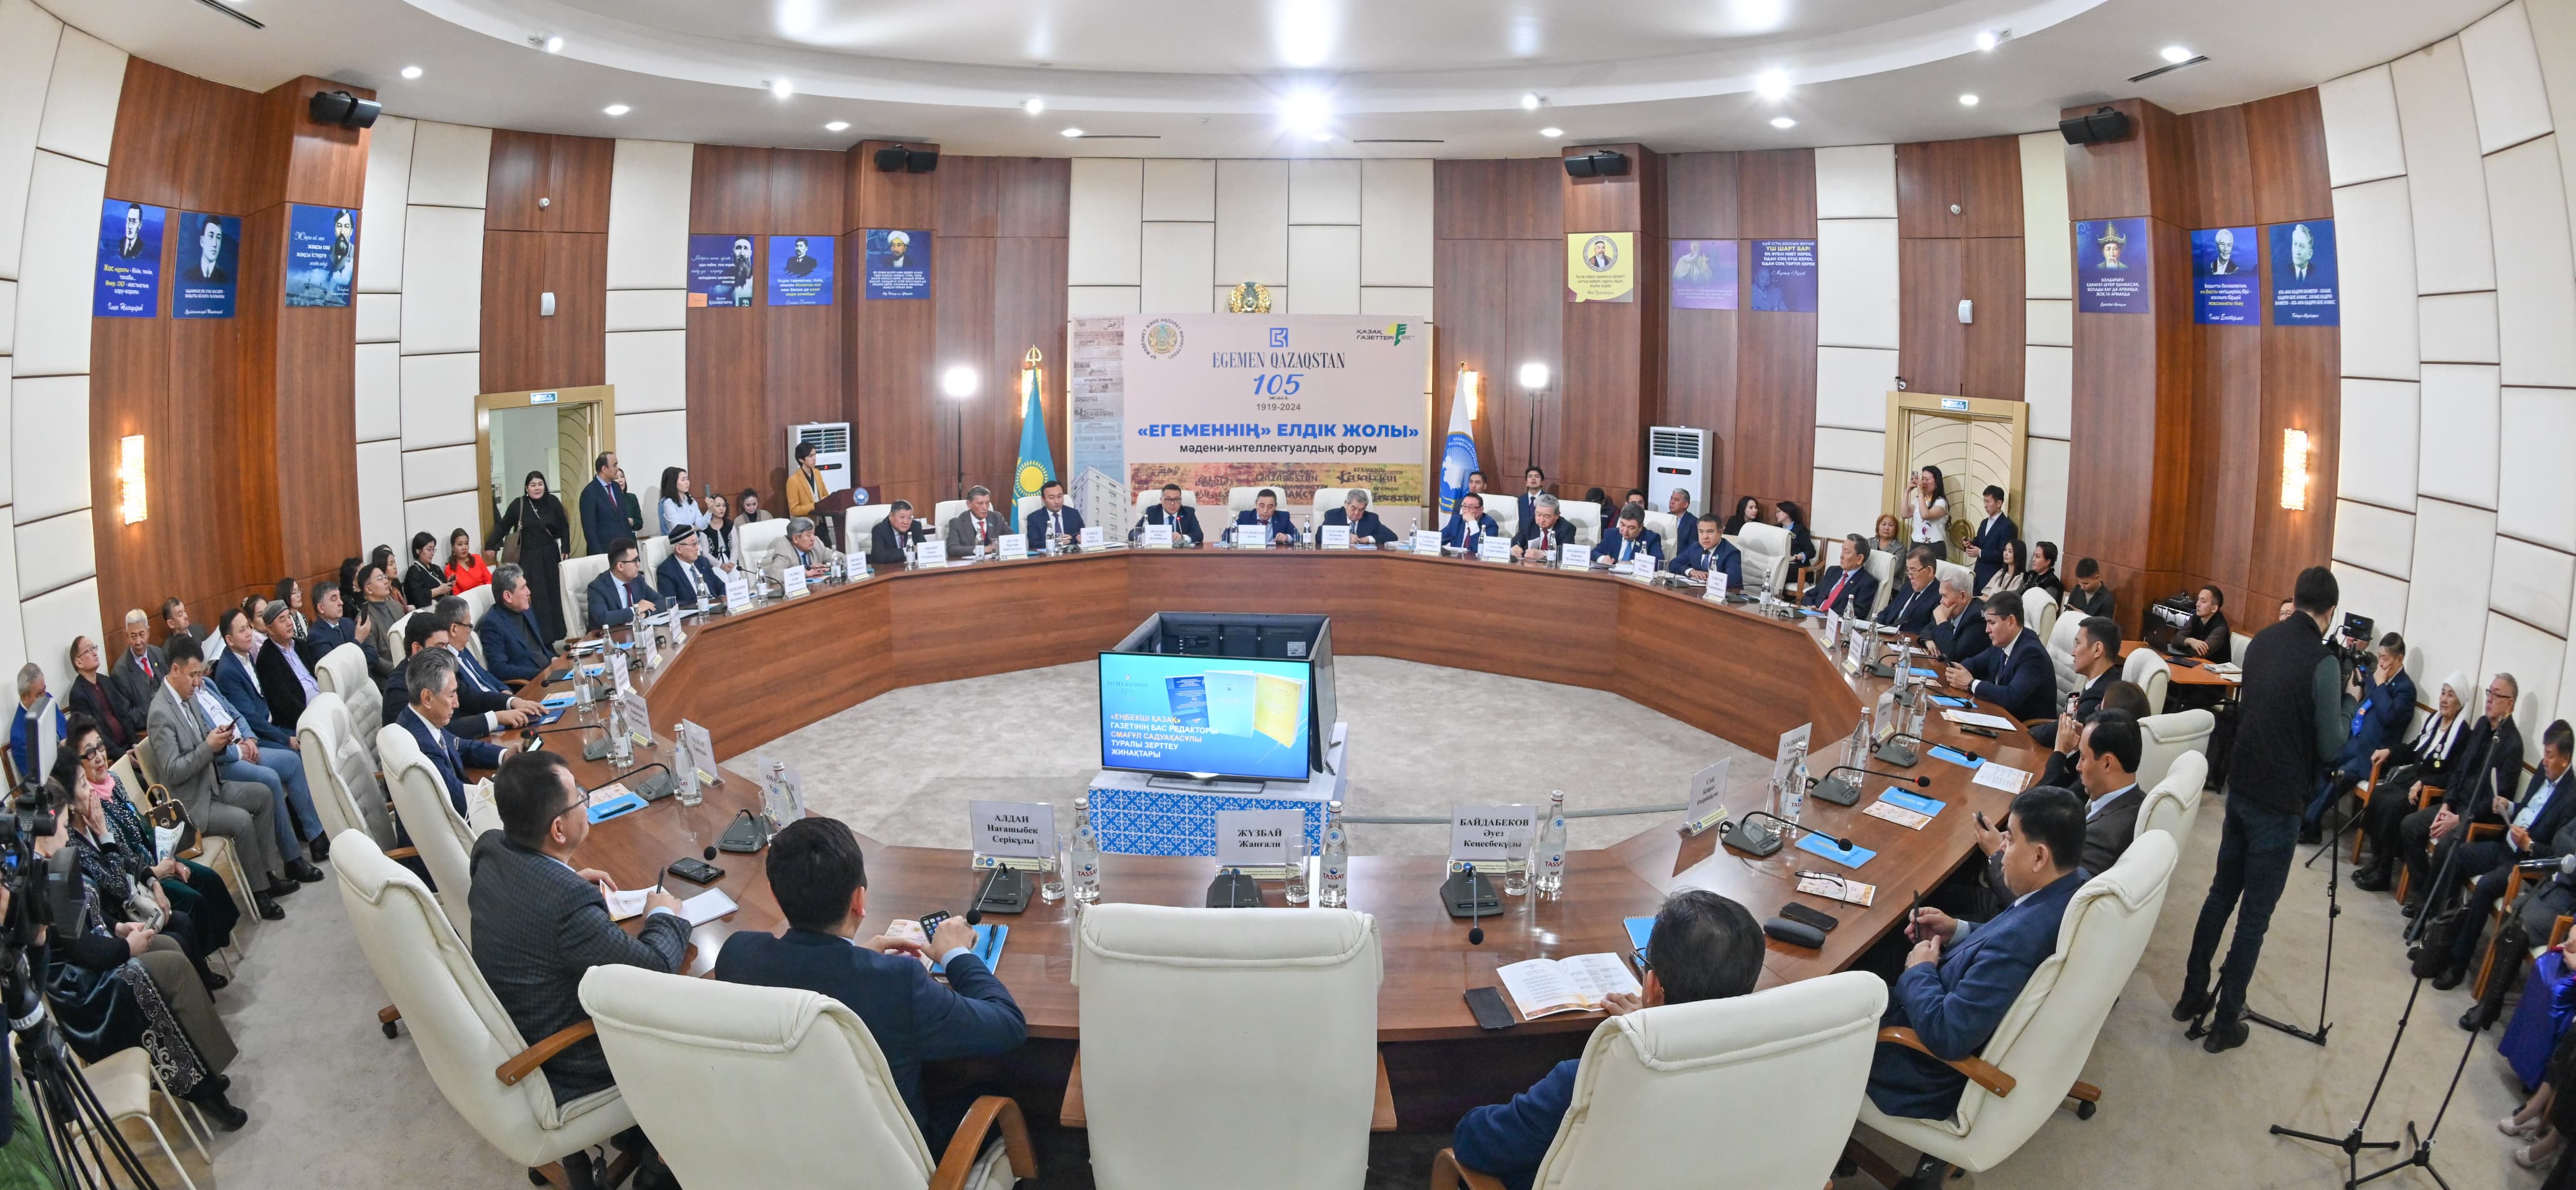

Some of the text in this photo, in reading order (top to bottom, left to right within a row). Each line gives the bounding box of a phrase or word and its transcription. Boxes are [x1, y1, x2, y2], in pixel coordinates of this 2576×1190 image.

[1160, 318, 1182, 330] АҚПАРАТ
[1212, 352, 1346, 369] EGEMEN QAZAQSTAN
[1253, 373, 1305, 395] 105
[1256, 403, 1301, 411] 1919-2024
[1138, 423, 1271, 440] «ЕГЕМЕННІҢ»
[1277, 423, 1337, 439] ЕЛДІК
[1342, 423, 1419, 438] ЖОЛЫ»
[1180, 443, 1377, 455] мәдени-интеллектуалдық форум
[1110, 713, 1181, 726] «ЕҢБЕКШІ ҚАЗАҚ»
[1111, 722, 1150, 732] ГАЗЕТІНІҢ
[1169, 725, 1219, 735] РЕДАКТОРЫ
[1111, 739, 1179, 750] ТУРАЛЫ ЗЕРТТЕУ
[1111, 748, 1161, 758] ЖИНАҚТАРЫ
[995, 815, 1029, 823] АЛДАН
[1460, 817, 1529, 827] БАЙДАБЕКОВ
[987, 824, 1038, 834] Нағашыбек
[1237, 828, 1282, 837] ЖҮЗБАЙ
[1483, 830, 1504, 839] Әуез
[992, 835, 1035, 845] Серікұлы
[1323, 872, 1345, 880] TASSAY
